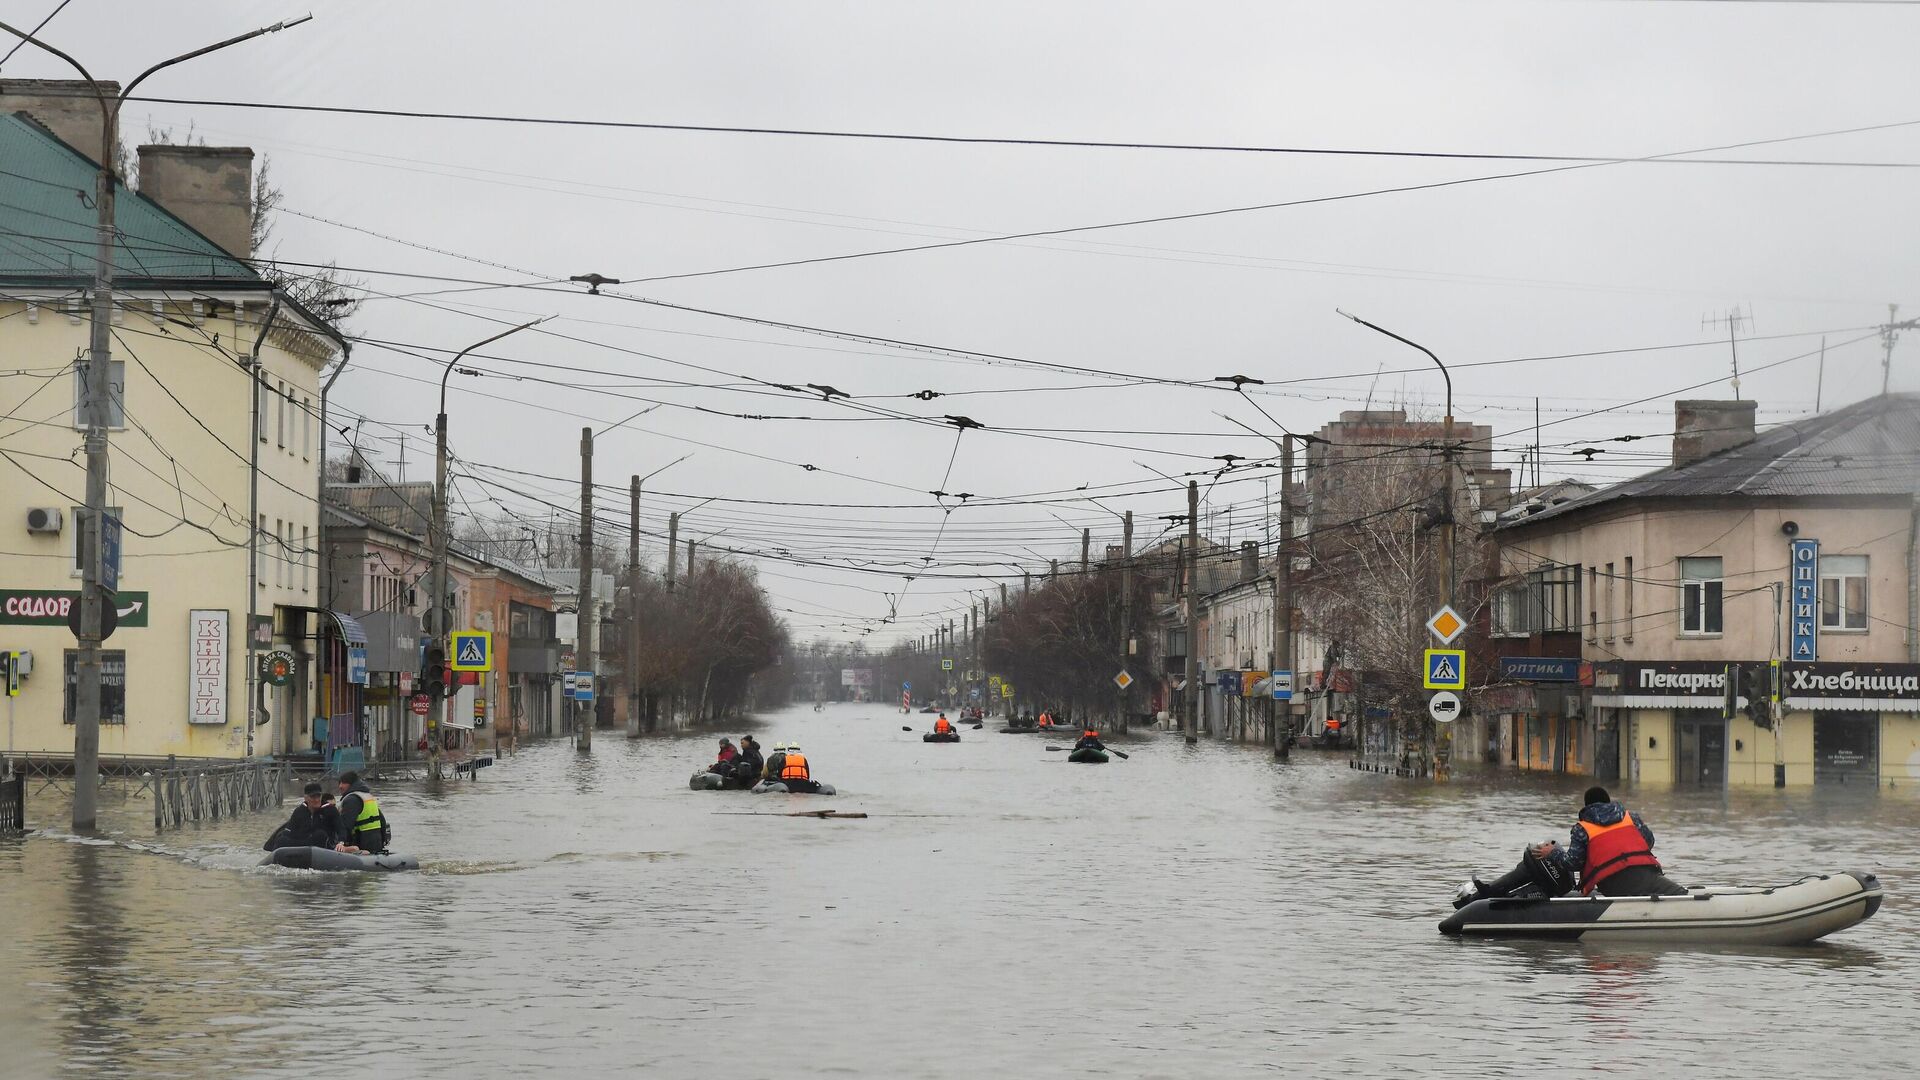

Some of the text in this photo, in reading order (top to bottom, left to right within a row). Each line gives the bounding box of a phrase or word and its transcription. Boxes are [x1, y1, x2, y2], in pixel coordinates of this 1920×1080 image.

[1798, 548, 1813, 655] ОПТИКА
[197, 620, 220, 716] КНИГИ
[1507, 664, 1564, 674] ОПТИКА
[1640, 668, 1726, 693] Пекарня
[1791, 670, 1919, 694] Хлебница
